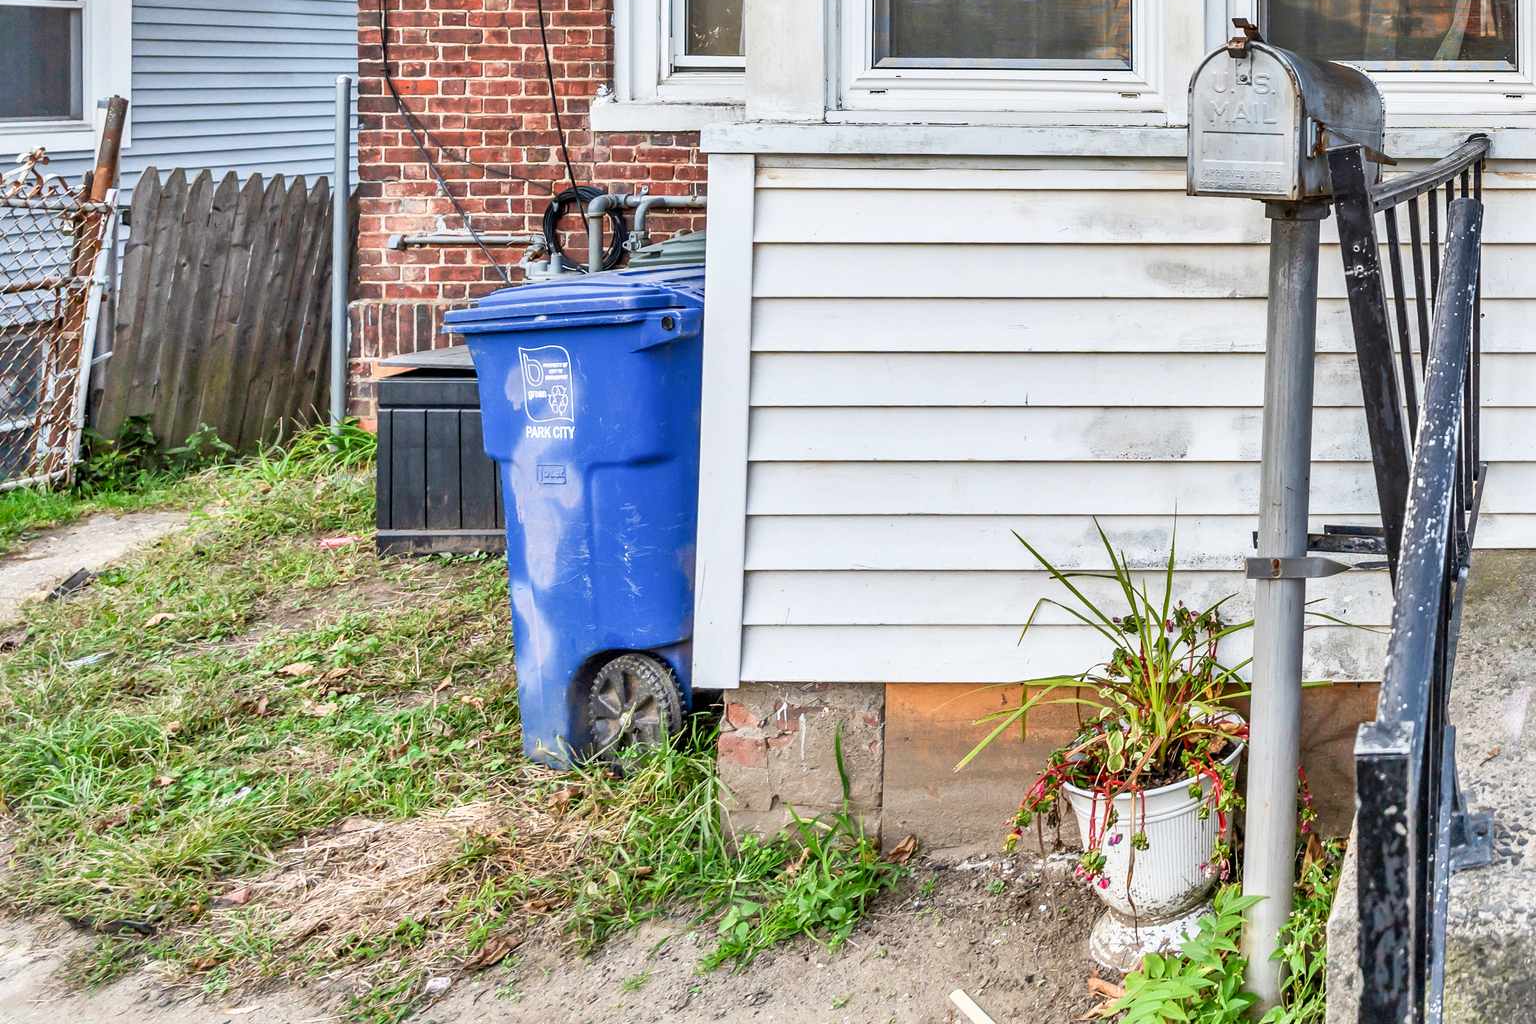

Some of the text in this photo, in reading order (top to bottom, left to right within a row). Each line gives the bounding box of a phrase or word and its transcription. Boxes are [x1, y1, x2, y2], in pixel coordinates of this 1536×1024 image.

[1209, 100, 1278, 125] MAIL
[1204, 168, 1281, 180] APPROVED BY THE
[528, 390, 547, 401] green
[525, 425, 576, 439] PARK CITY
